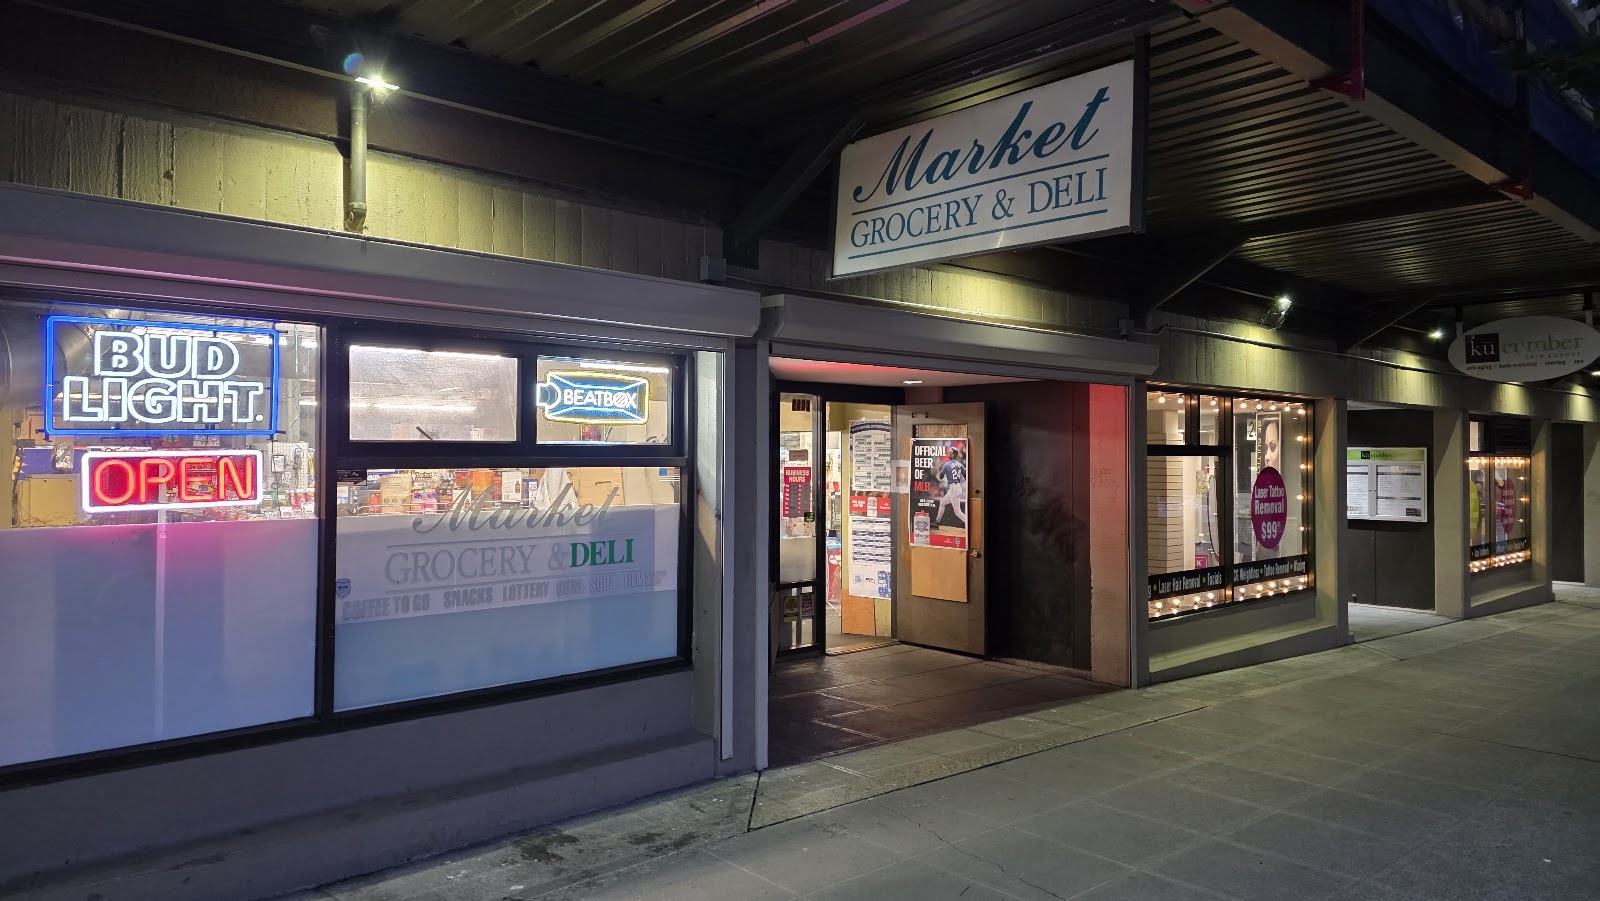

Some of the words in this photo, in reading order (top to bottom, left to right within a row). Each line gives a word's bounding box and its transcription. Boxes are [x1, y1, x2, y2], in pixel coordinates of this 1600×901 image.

[852, 86, 1110, 203] Market
[850, 194, 984, 248] GROCERY
[991, 189, 1015, 220] &
[1027, 167, 1108, 214] DELI
[94, 330, 240, 379] BUD
[563, 389, 637, 408] BEATBOX
[914, 445, 946, 456] OFFICIAL
[914, 457, 933, 468] BEER
[95, 457, 252, 504] OPEN
[914, 469, 924, 480] OF
[914, 481, 931, 492] MLB
[1254, 485, 1268, 498] Laser
[1269, 485, 1285, 497] Tattoo
[412, 483, 620, 534] Market
[1254, 498, 1285, 515] Removal
[384, 543, 537, 585] GROCERY
[547, 542, 569, 571] &
[569, 539, 635, 568] DELI
[1263, 564, 1275, 577] Tattoo
[1275, 561, 1290, 575] Removal
[1158, 579, 1171, 593] Laser
[1172, 576, 1182, 591] Hair
[1182, 573, 1201, 590] Removal
[1207, 571, 1222, 586] Facials
[342, 597, 391, 621] COFFEE
[394, 595, 410, 614] TO
[412, 593, 431, 611] GO
[443, 586, 494, 608] SNACKS
[502, 580, 549, 601] LOTTERY
[589, 575, 616, 593] SODA
